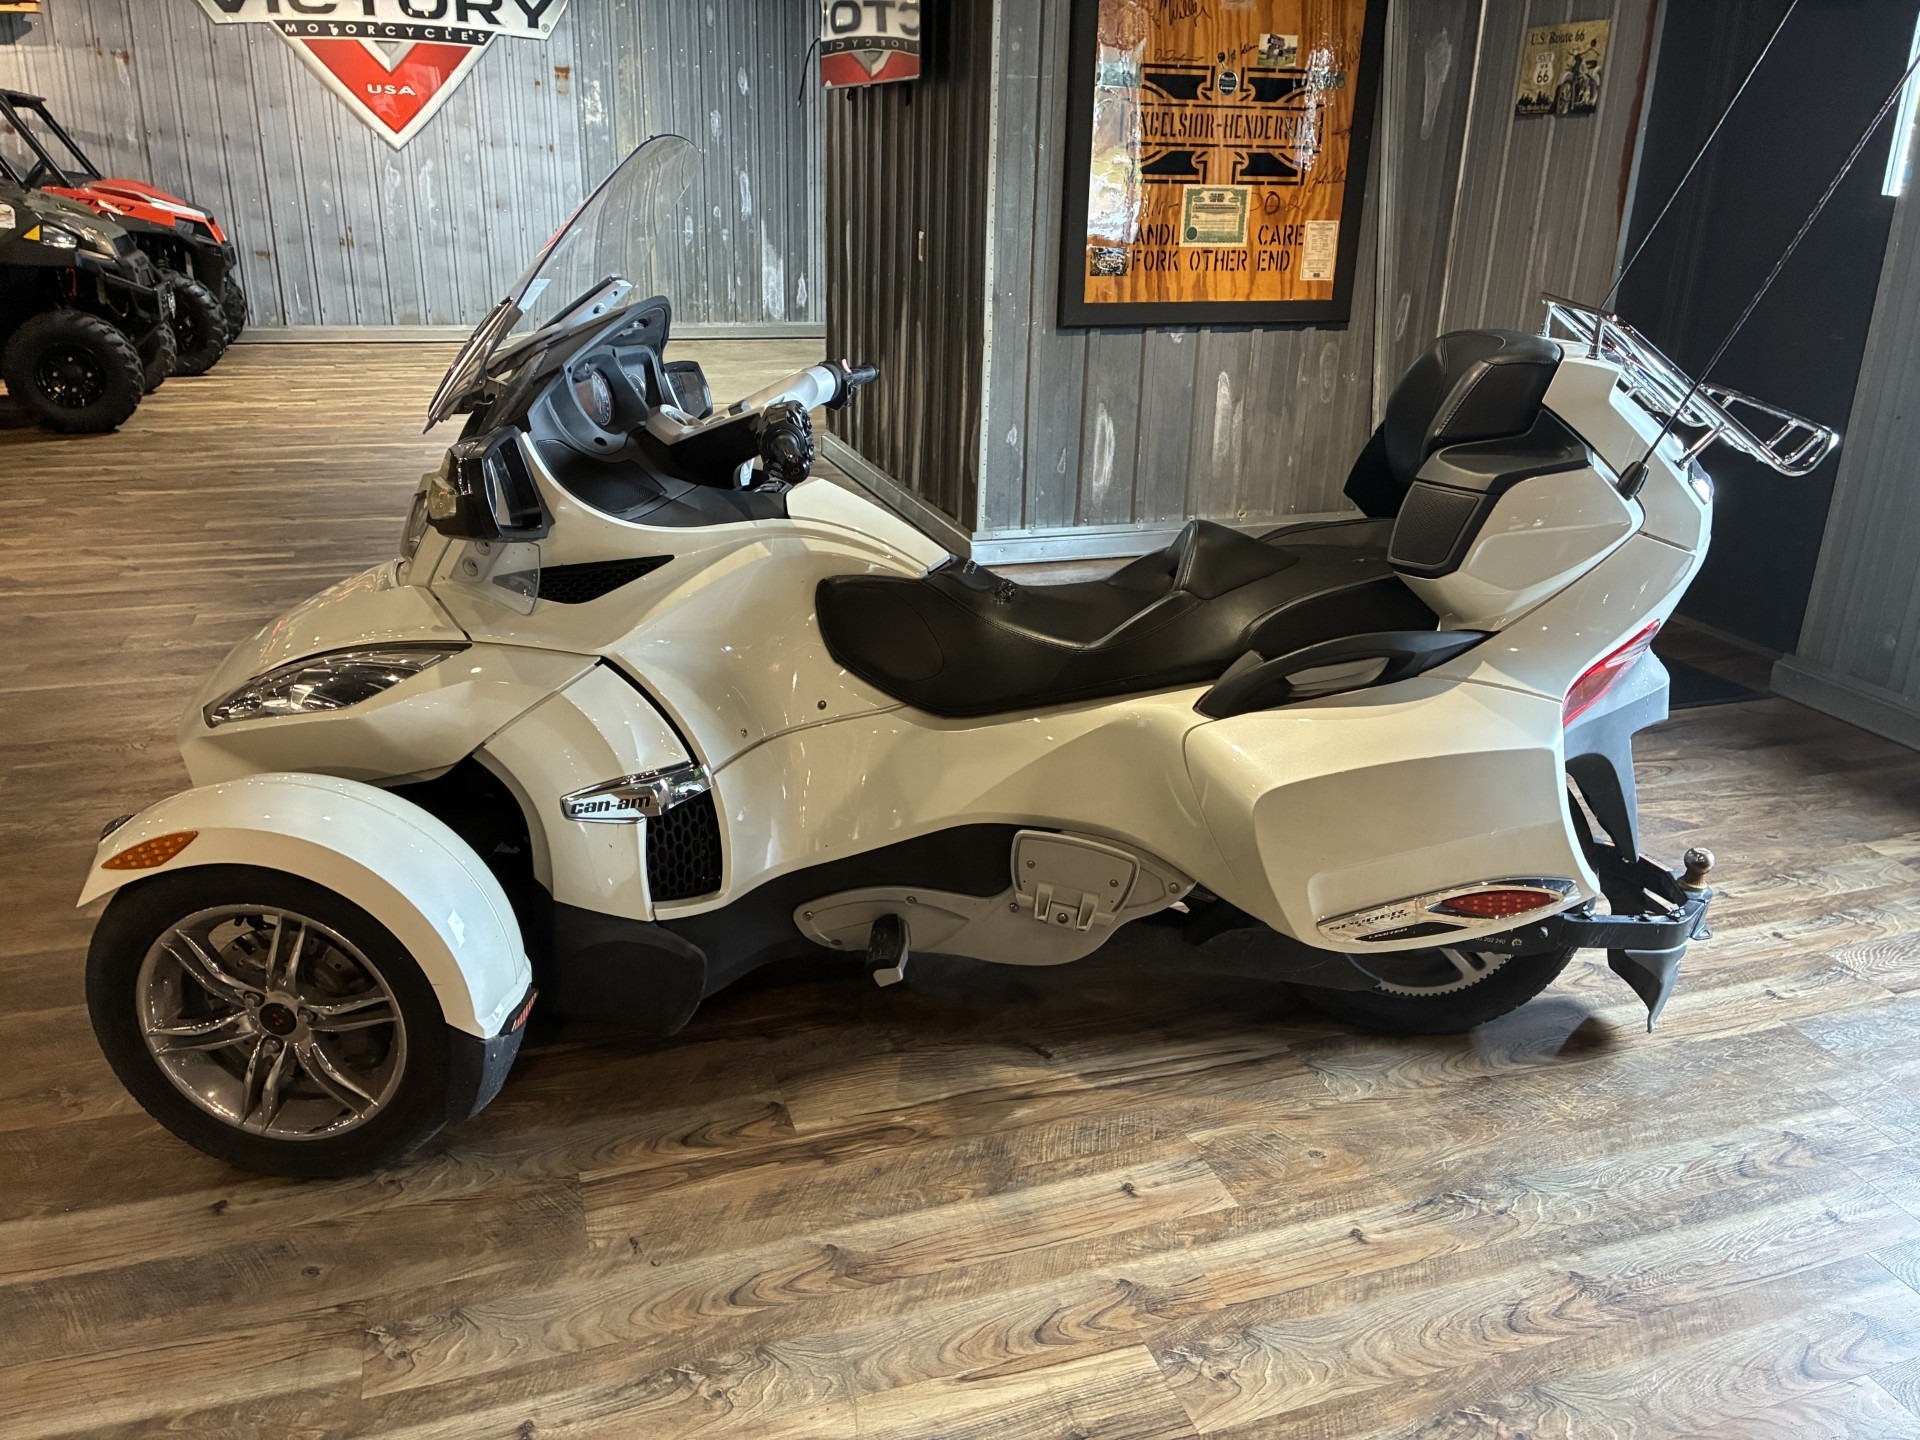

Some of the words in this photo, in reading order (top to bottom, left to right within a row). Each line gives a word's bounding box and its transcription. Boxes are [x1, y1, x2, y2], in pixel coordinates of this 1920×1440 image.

[284, 22, 486, 43] MOTORCYCLES
[1549, 31, 1573, 44] Route
[1575, 28, 1585, 41] 66
[1537, 71, 1549, 83] 66
[366, 83, 416, 96] USA
[1258, 224, 1305, 246] CARE
[1131, 249, 1178, 271] FORK
[1189, 250, 1248, 271] OTHER
[1257, 250, 1290, 271] END
[570, 797, 651, 815] can-am
